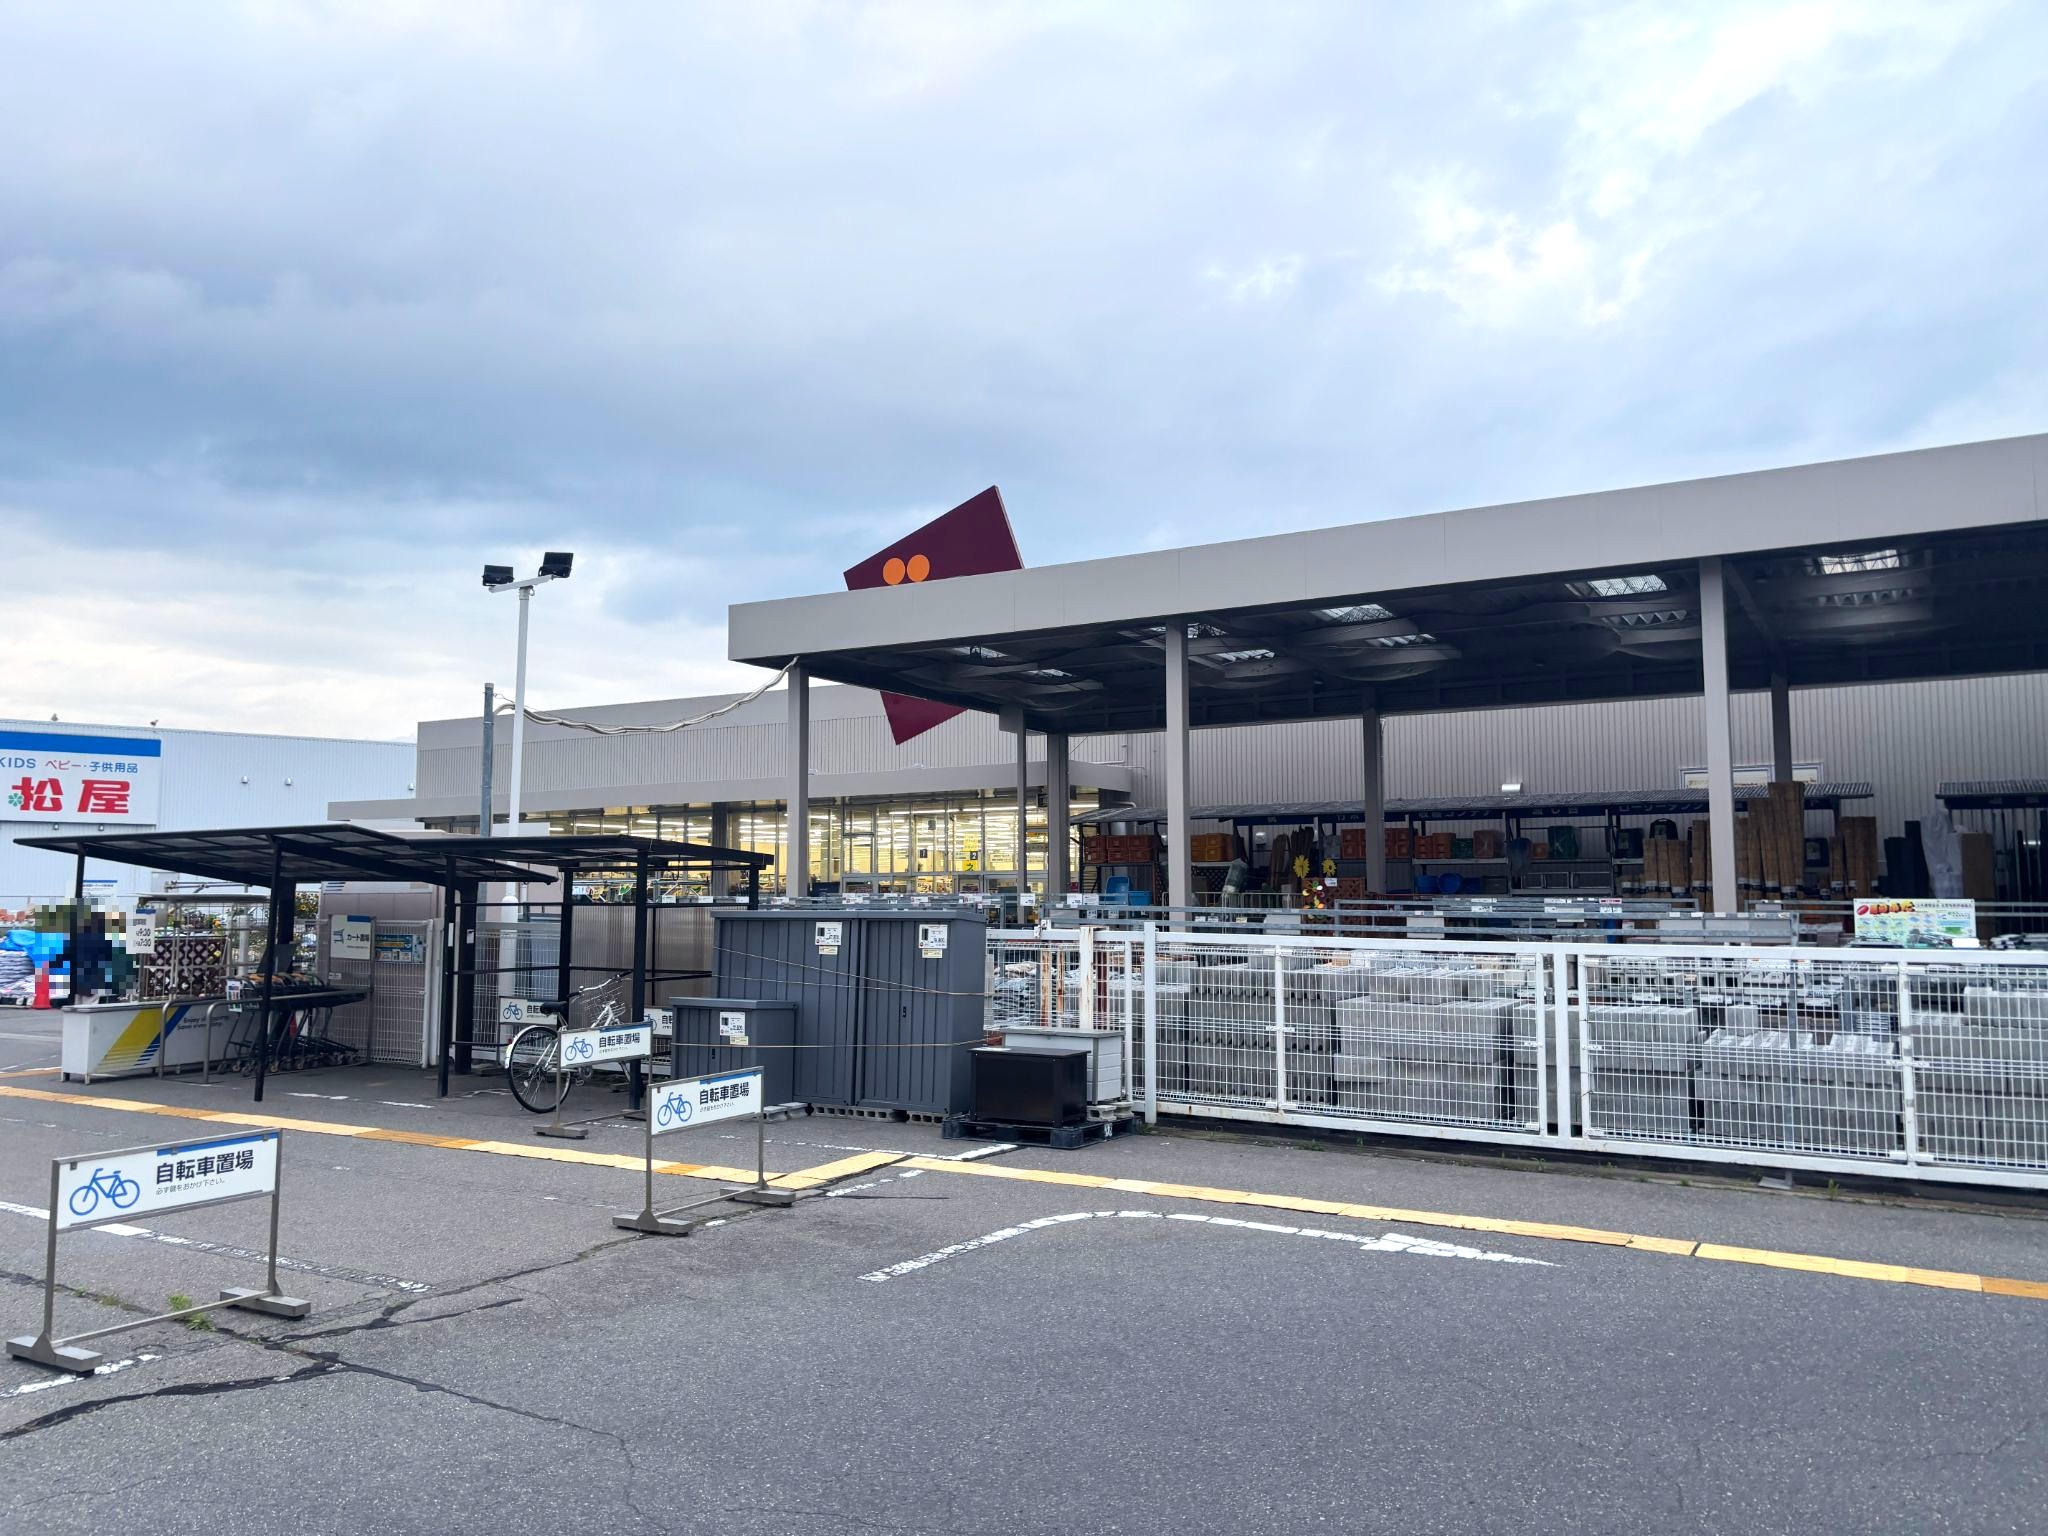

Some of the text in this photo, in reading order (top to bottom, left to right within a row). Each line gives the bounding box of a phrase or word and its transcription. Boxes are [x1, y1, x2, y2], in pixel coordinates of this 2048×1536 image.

[12, 777, 130, 814] 松屋
[599, 1032, 641, 1048] 自転車置場
[699, 1081, 750, 1105] 自転車置場
[156, 1149, 254, 1185] 自転車置場
